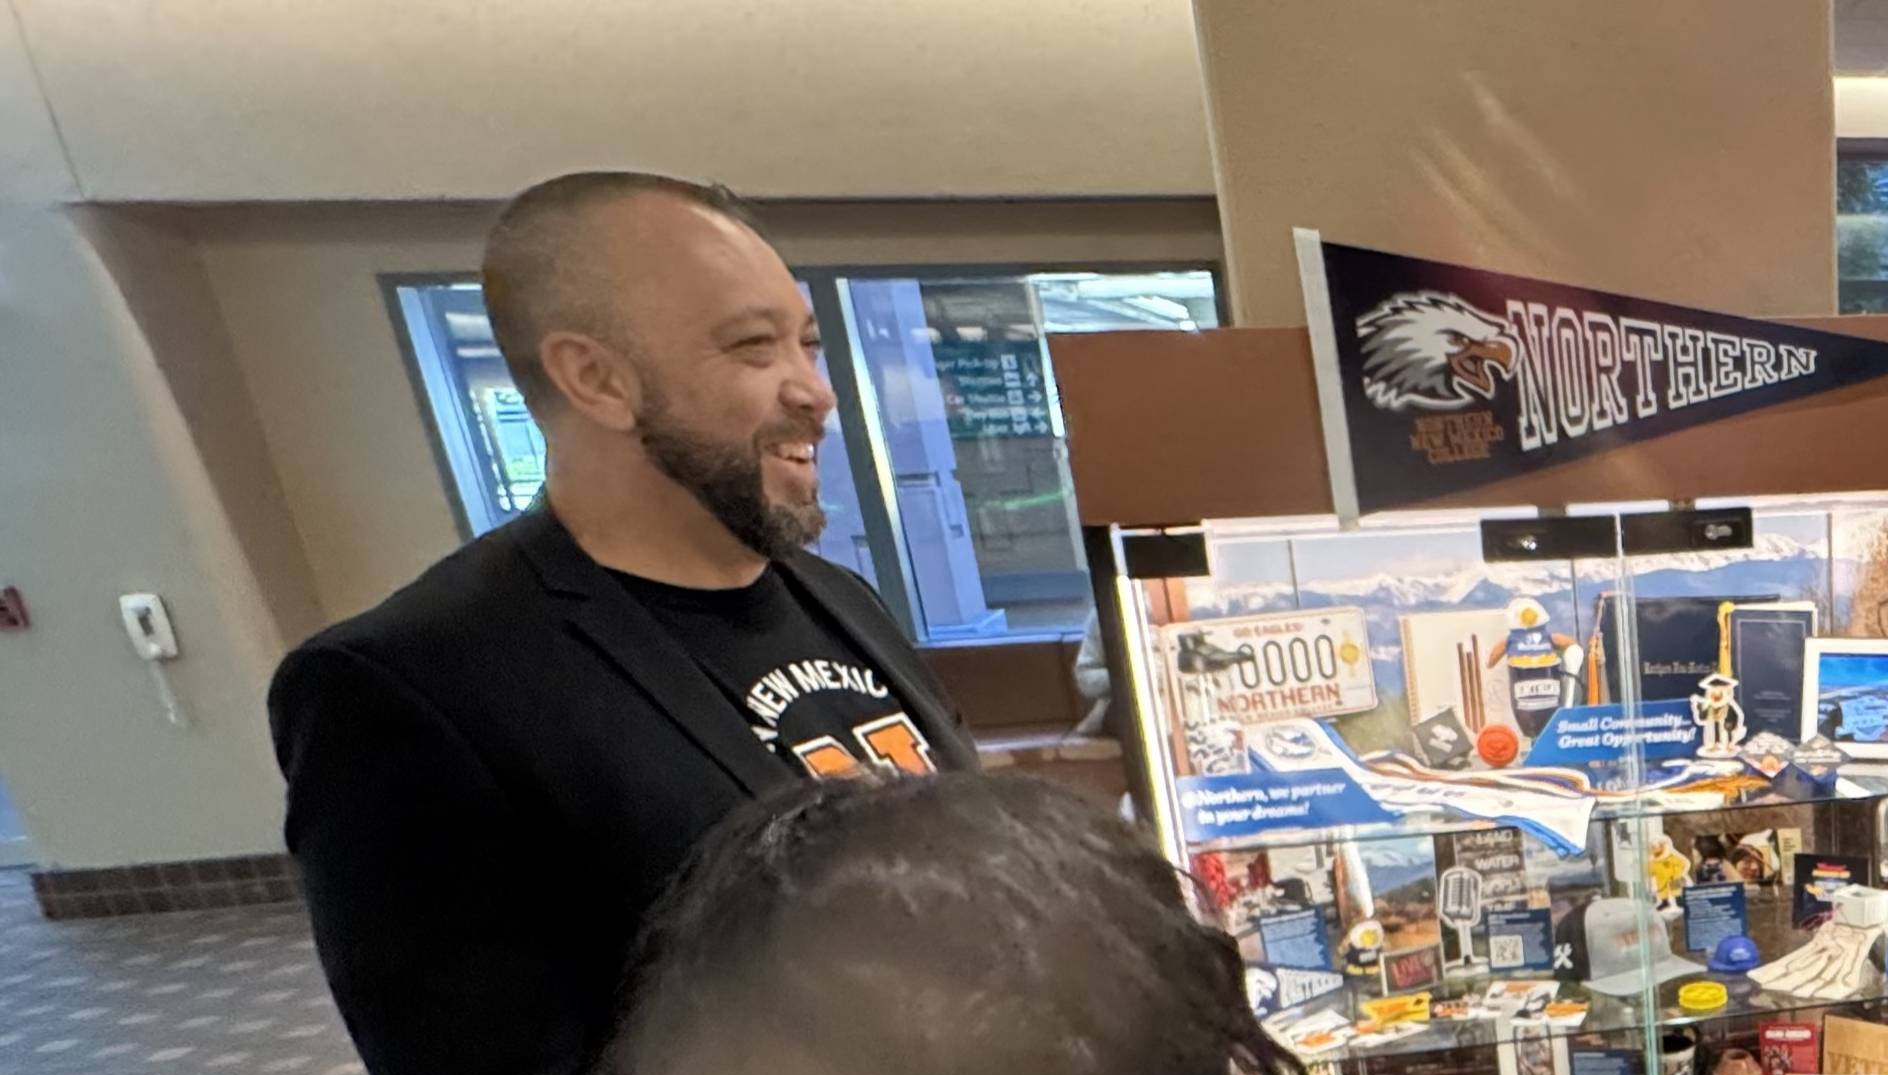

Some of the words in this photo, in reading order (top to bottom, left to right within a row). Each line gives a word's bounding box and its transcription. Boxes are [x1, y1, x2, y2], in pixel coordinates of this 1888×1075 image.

[1506, 299, 1817, 452] NORTHERN
[1238, 634, 1337, 689] 0000
[746, 668, 800, 728] NEW
[788, 659, 889, 699] MEXIC
[1216, 682, 1341, 713] NORTHERN
[1557, 718, 1598, 734] Small
[1558, 733, 1600, 749] Great
[1291, 782, 1347, 800] partner
